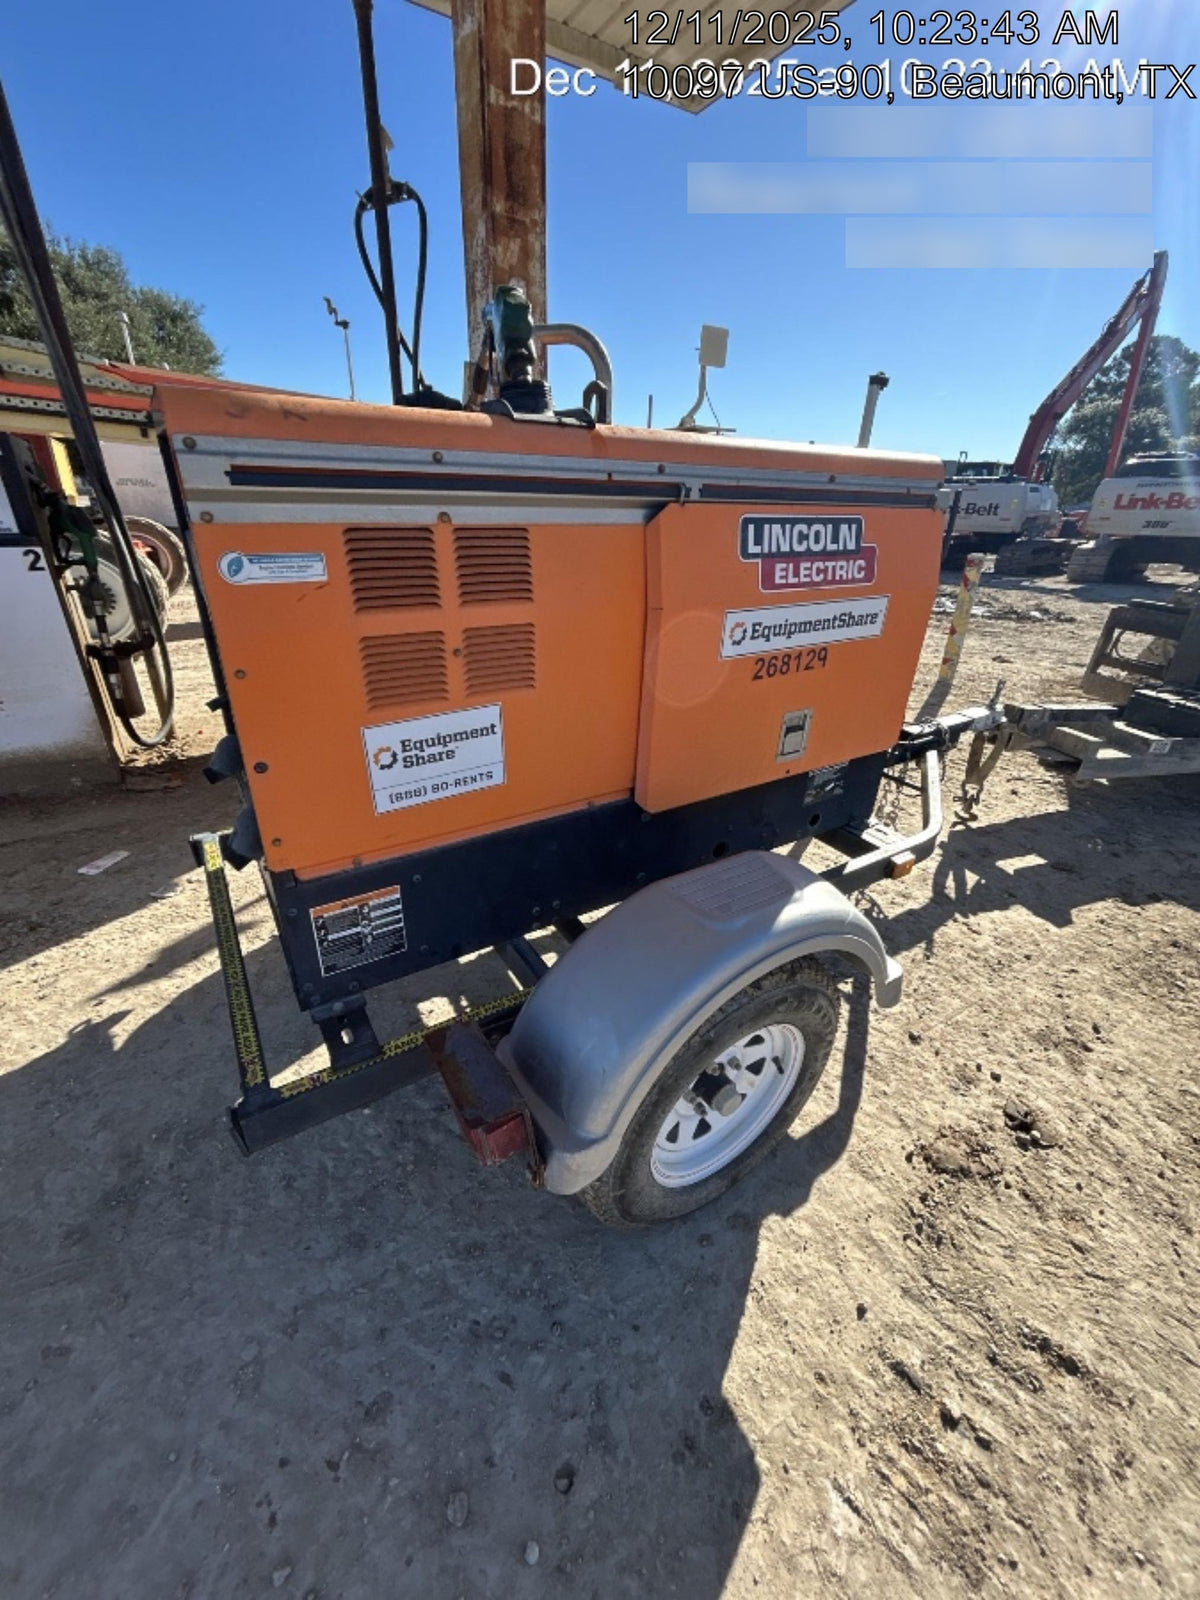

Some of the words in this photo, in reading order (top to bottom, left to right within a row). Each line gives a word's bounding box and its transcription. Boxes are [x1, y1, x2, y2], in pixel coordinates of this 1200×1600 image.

[956, 502, 1000, 516] -Belt
[747, 523, 858, 554] LINCOLN
[22, 549, 46, 571] 2
[774, 559, 867, 585] ELECTRIC
[749, 611, 879, 643] EquipmentShare
[752, 647, 829, 682] 268129
[400, 722, 498, 754] Equipment
[402, 749, 456, 769] Share
[431, 770, 494, 794] 80-RENTS
